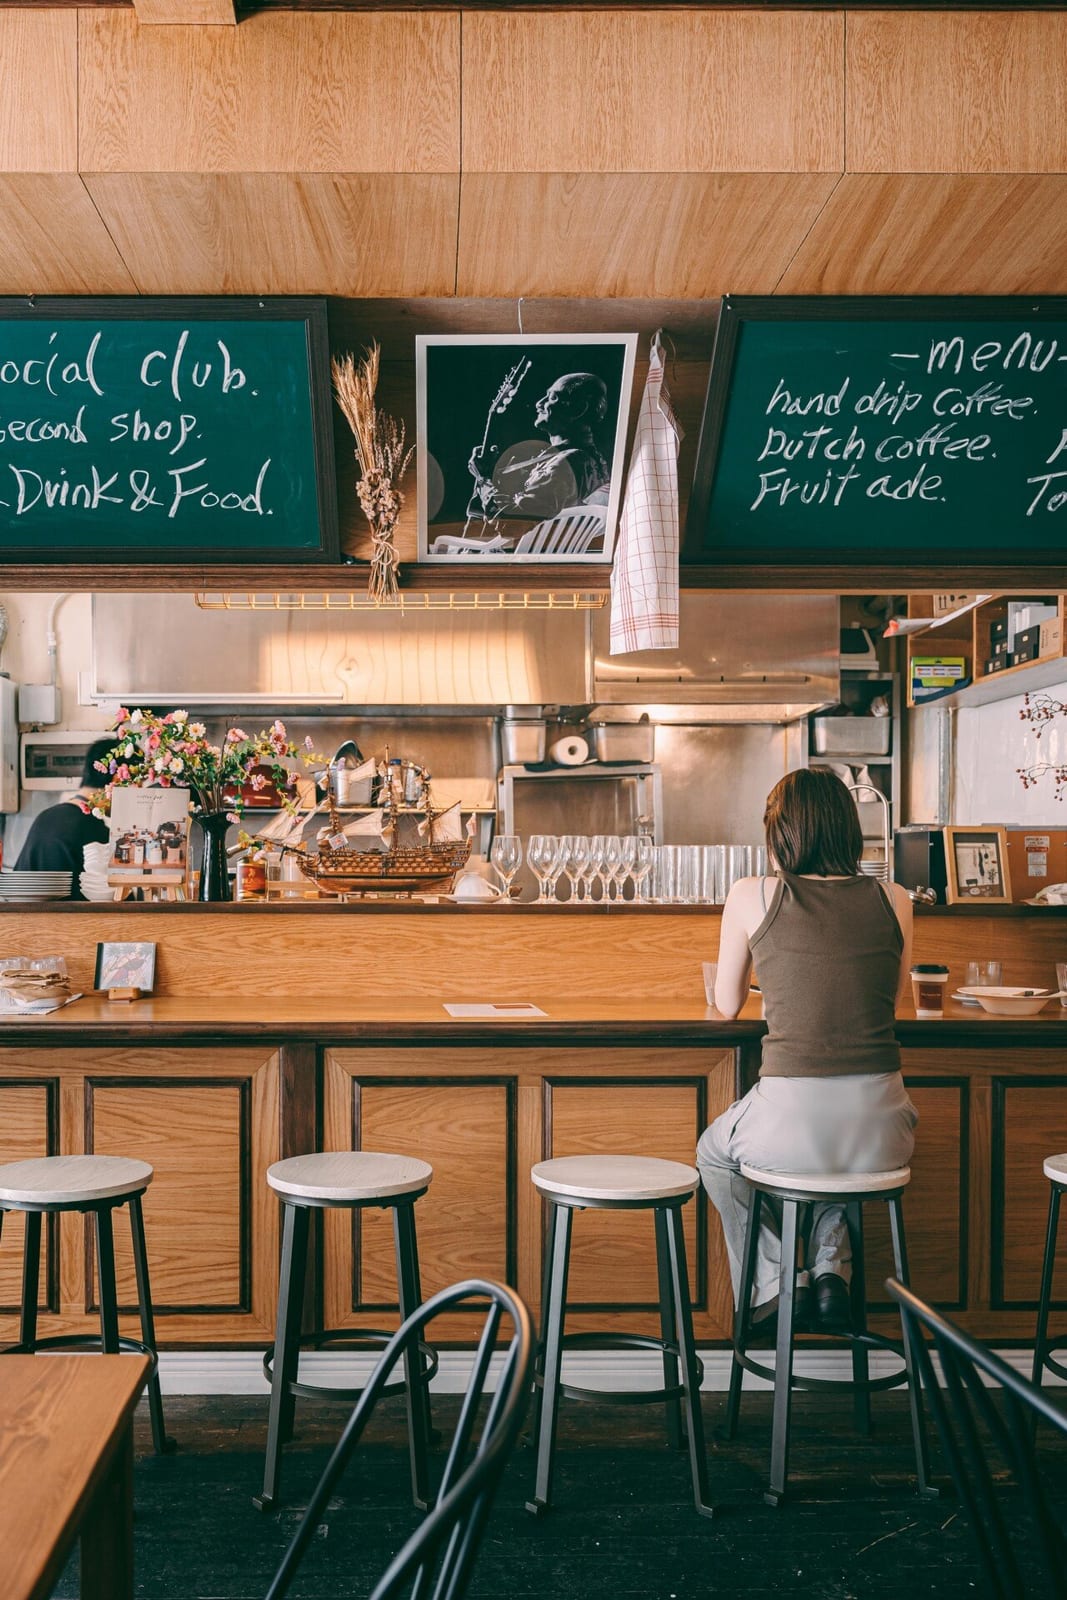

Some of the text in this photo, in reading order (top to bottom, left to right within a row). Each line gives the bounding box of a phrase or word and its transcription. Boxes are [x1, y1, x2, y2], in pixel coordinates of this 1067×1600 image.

[765, 376, 850, 416] hand
[854, 377, 923, 425] drip
[757, 424, 866, 462] Dutch
[750, 463, 861, 511] Fruit
